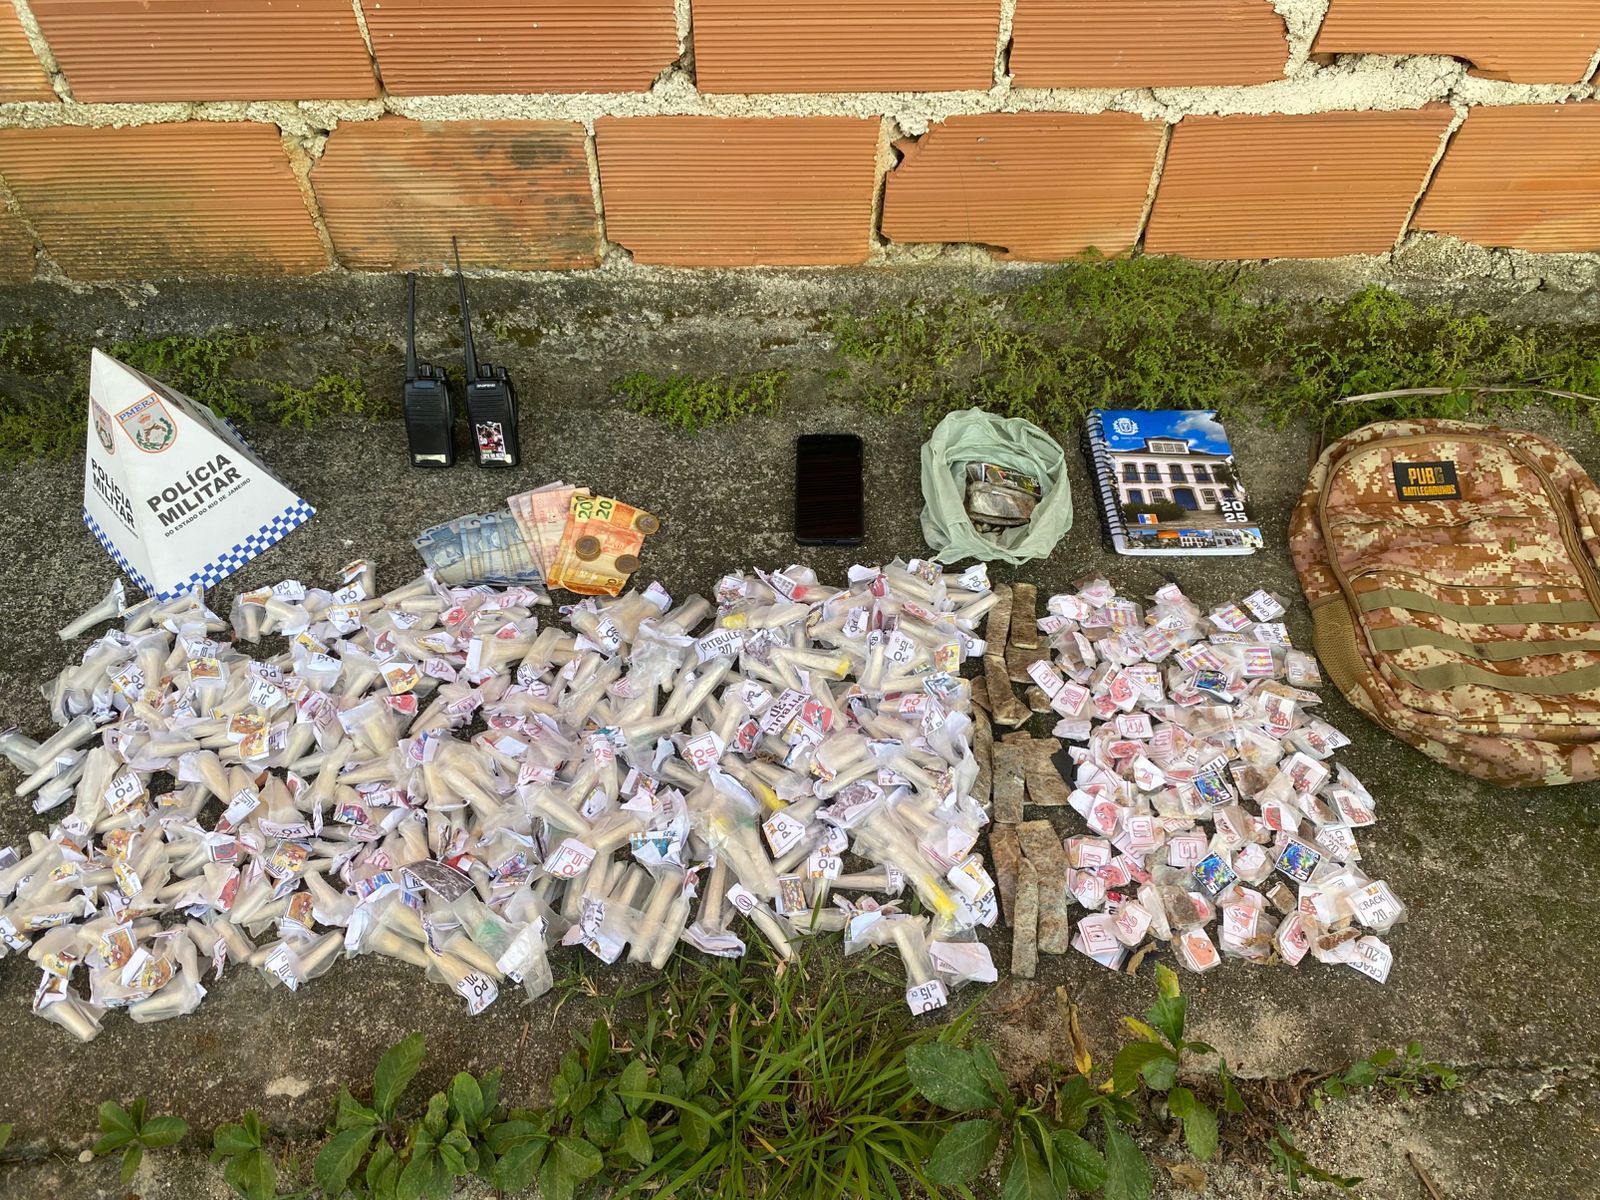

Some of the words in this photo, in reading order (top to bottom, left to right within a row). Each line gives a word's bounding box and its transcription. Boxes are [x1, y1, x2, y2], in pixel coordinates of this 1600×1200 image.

[119, 396, 155, 421] PMERJ
[146, 454, 232, 513] POLÍCIA
[1408, 466, 1445, 485] PUBG
[91, 457, 133, 514] POLÍCIA
[1402, 485, 1457, 497] BATTLEGROUNDS
[93, 472, 135, 529] MILITAR
[157, 467, 242, 527] MILITAR
[1220, 500, 1244, 511] 20
[164, 529, 174, 537] DO
[174, 514, 198, 531] ESTADO
[199, 508, 208, 516] DO
[207, 500, 219, 509] RIO
[218, 495, 227, 503] DE
[227, 478, 251, 497] JANEIRO
[578, 500, 594, 520] 20
[595, 499, 613, 520] 20
[1224, 512, 1248, 522] 25
[276, 580, 290, 594] PO
[969, 575, 982, 588] PO
[340, 590, 357, 603] PO
[1249, 599, 1270, 617] CRACK
[1271, 623, 1284, 644] CRACK
[258, 682, 276, 695] PO
[904, 698, 920, 707] PO
[1060, 689, 1083, 710] 20
[767, 695, 806, 732] PITBULL
[694, 750, 708, 766] PO
[115, 782, 134, 798] PO
[777, 821, 791, 839] PO
[1326, 840, 1339, 853] 20
[818, 858, 836, 871] PO
[1359, 894, 1385, 911] CRACK
[1372, 908, 1387, 922] 20
[1364, 946, 1380, 961] 20
[474, 978, 490, 998] PO
[920, 987, 932, 1000] 15
